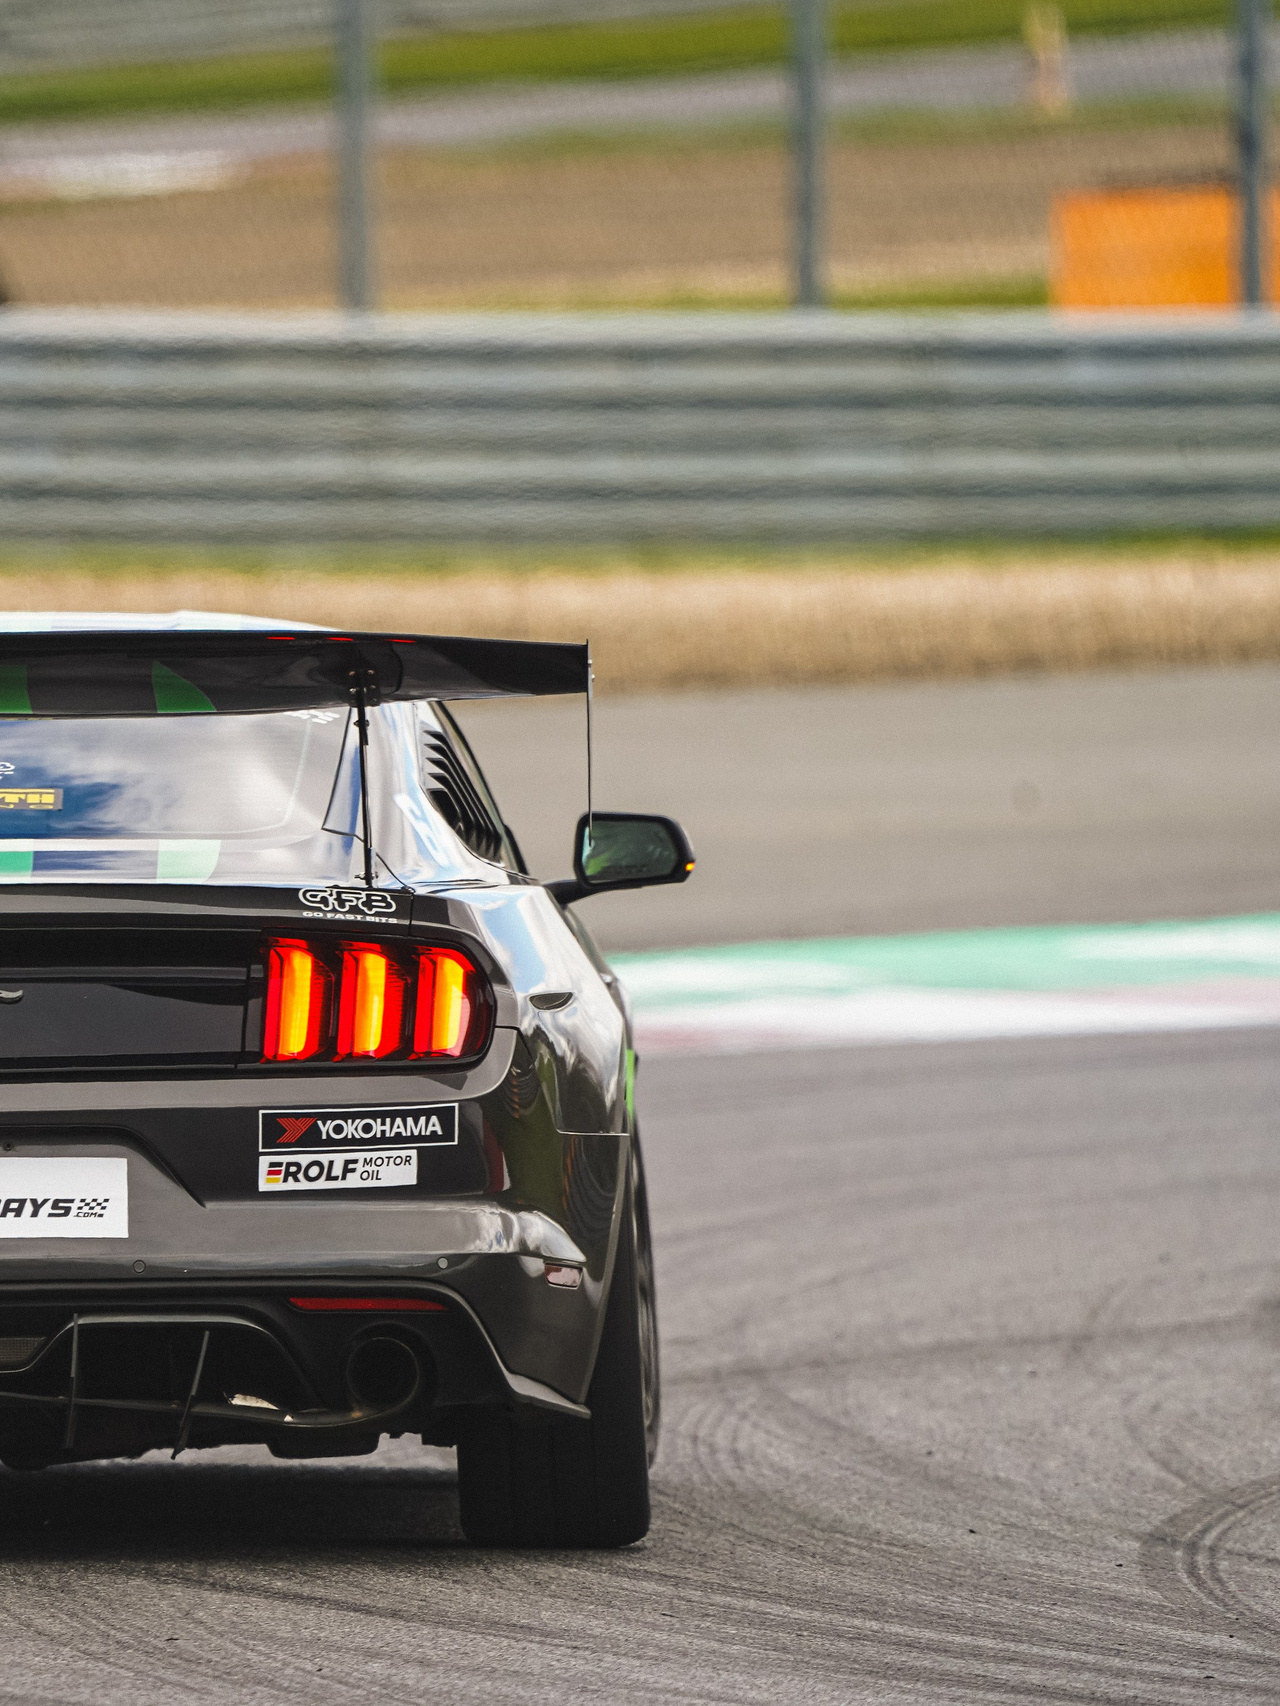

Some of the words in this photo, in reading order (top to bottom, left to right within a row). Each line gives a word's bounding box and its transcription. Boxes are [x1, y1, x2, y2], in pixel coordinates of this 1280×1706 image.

[298, 887, 396, 914] GFB
[366, 915, 398, 924] BITS
[317, 1115, 443, 1140] YOKOHAMA
[282, 1158, 359, 1183] ROLF
[362, 1155, 412, 1168] MOTOR
[359, 1169, 382, 1181] OIL
